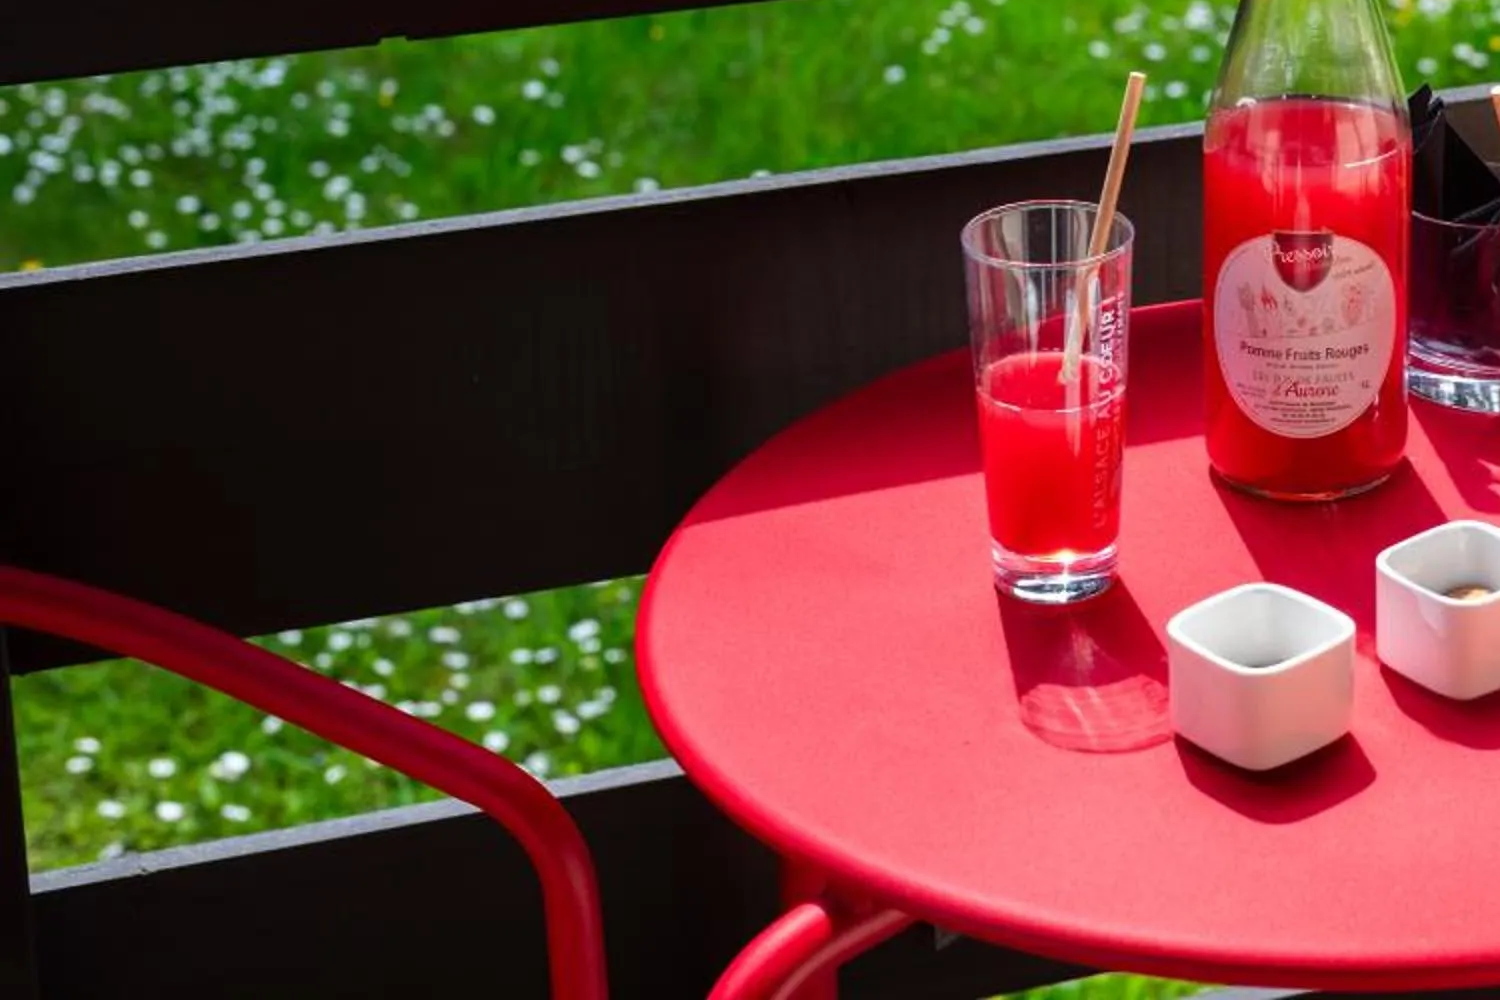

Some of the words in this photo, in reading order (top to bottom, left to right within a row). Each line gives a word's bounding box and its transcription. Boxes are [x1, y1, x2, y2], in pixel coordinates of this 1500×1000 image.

[1240, 340, 1283, 360] Pomme
[1285, 347, 1322, 361] Fruits
[1325, 342, 1370, 361] Rouges
